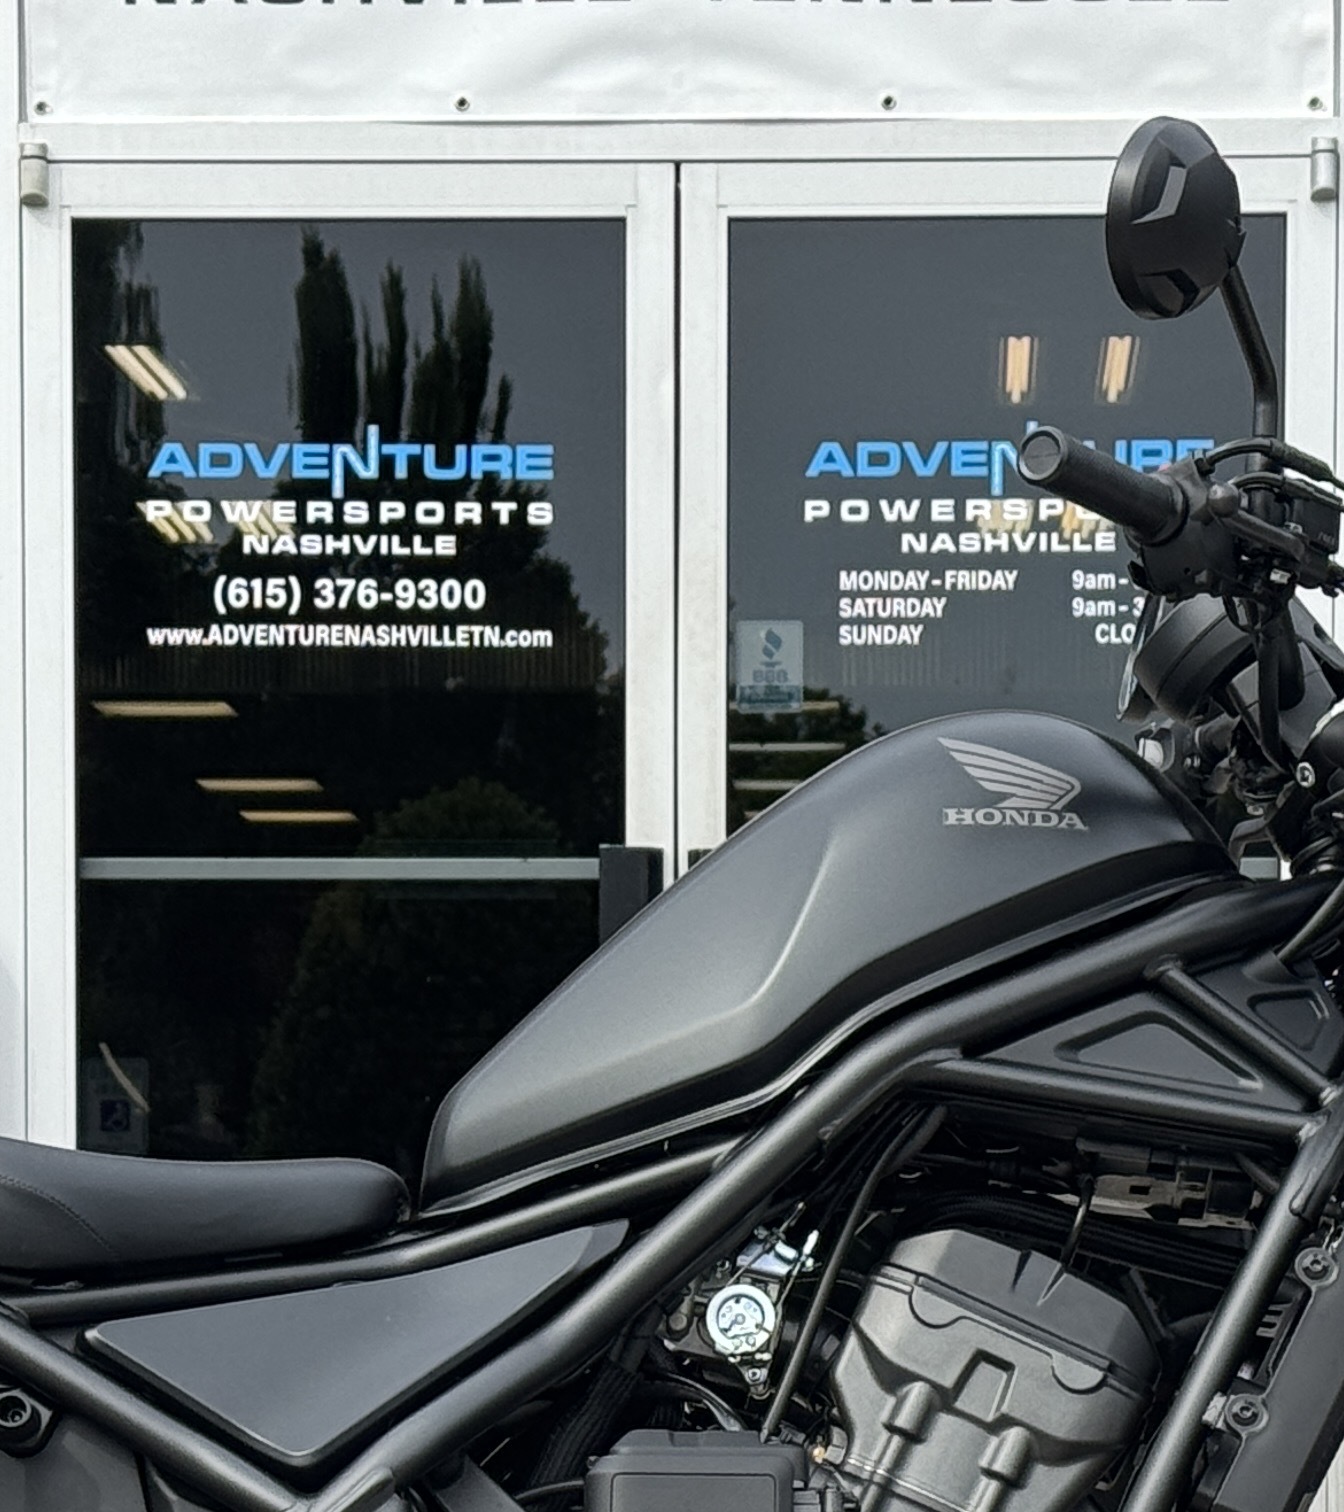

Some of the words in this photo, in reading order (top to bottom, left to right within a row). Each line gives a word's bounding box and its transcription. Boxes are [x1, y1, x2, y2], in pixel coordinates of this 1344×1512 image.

[147, 424, 555, 499] ADVENTURE
[145, 500, 554, 526] POWERSPORTS
[242, 535, 457, 556] NASHVILLE
[901, 532, 1117, 553] NASHVILLE
[213, 575, 302, 615] (615)
[313, 578, 486, 610] 376-9300
[838, 597, 947, 619] SATURDAY
[146, 624, 554, 648] www.ADVENTURENASHVILLETN.com
[838, 624, 924, 646] SUNDAY
[1095, 623, 1137, 645] CLO
[943, 808, 1088, 831] HONDA
